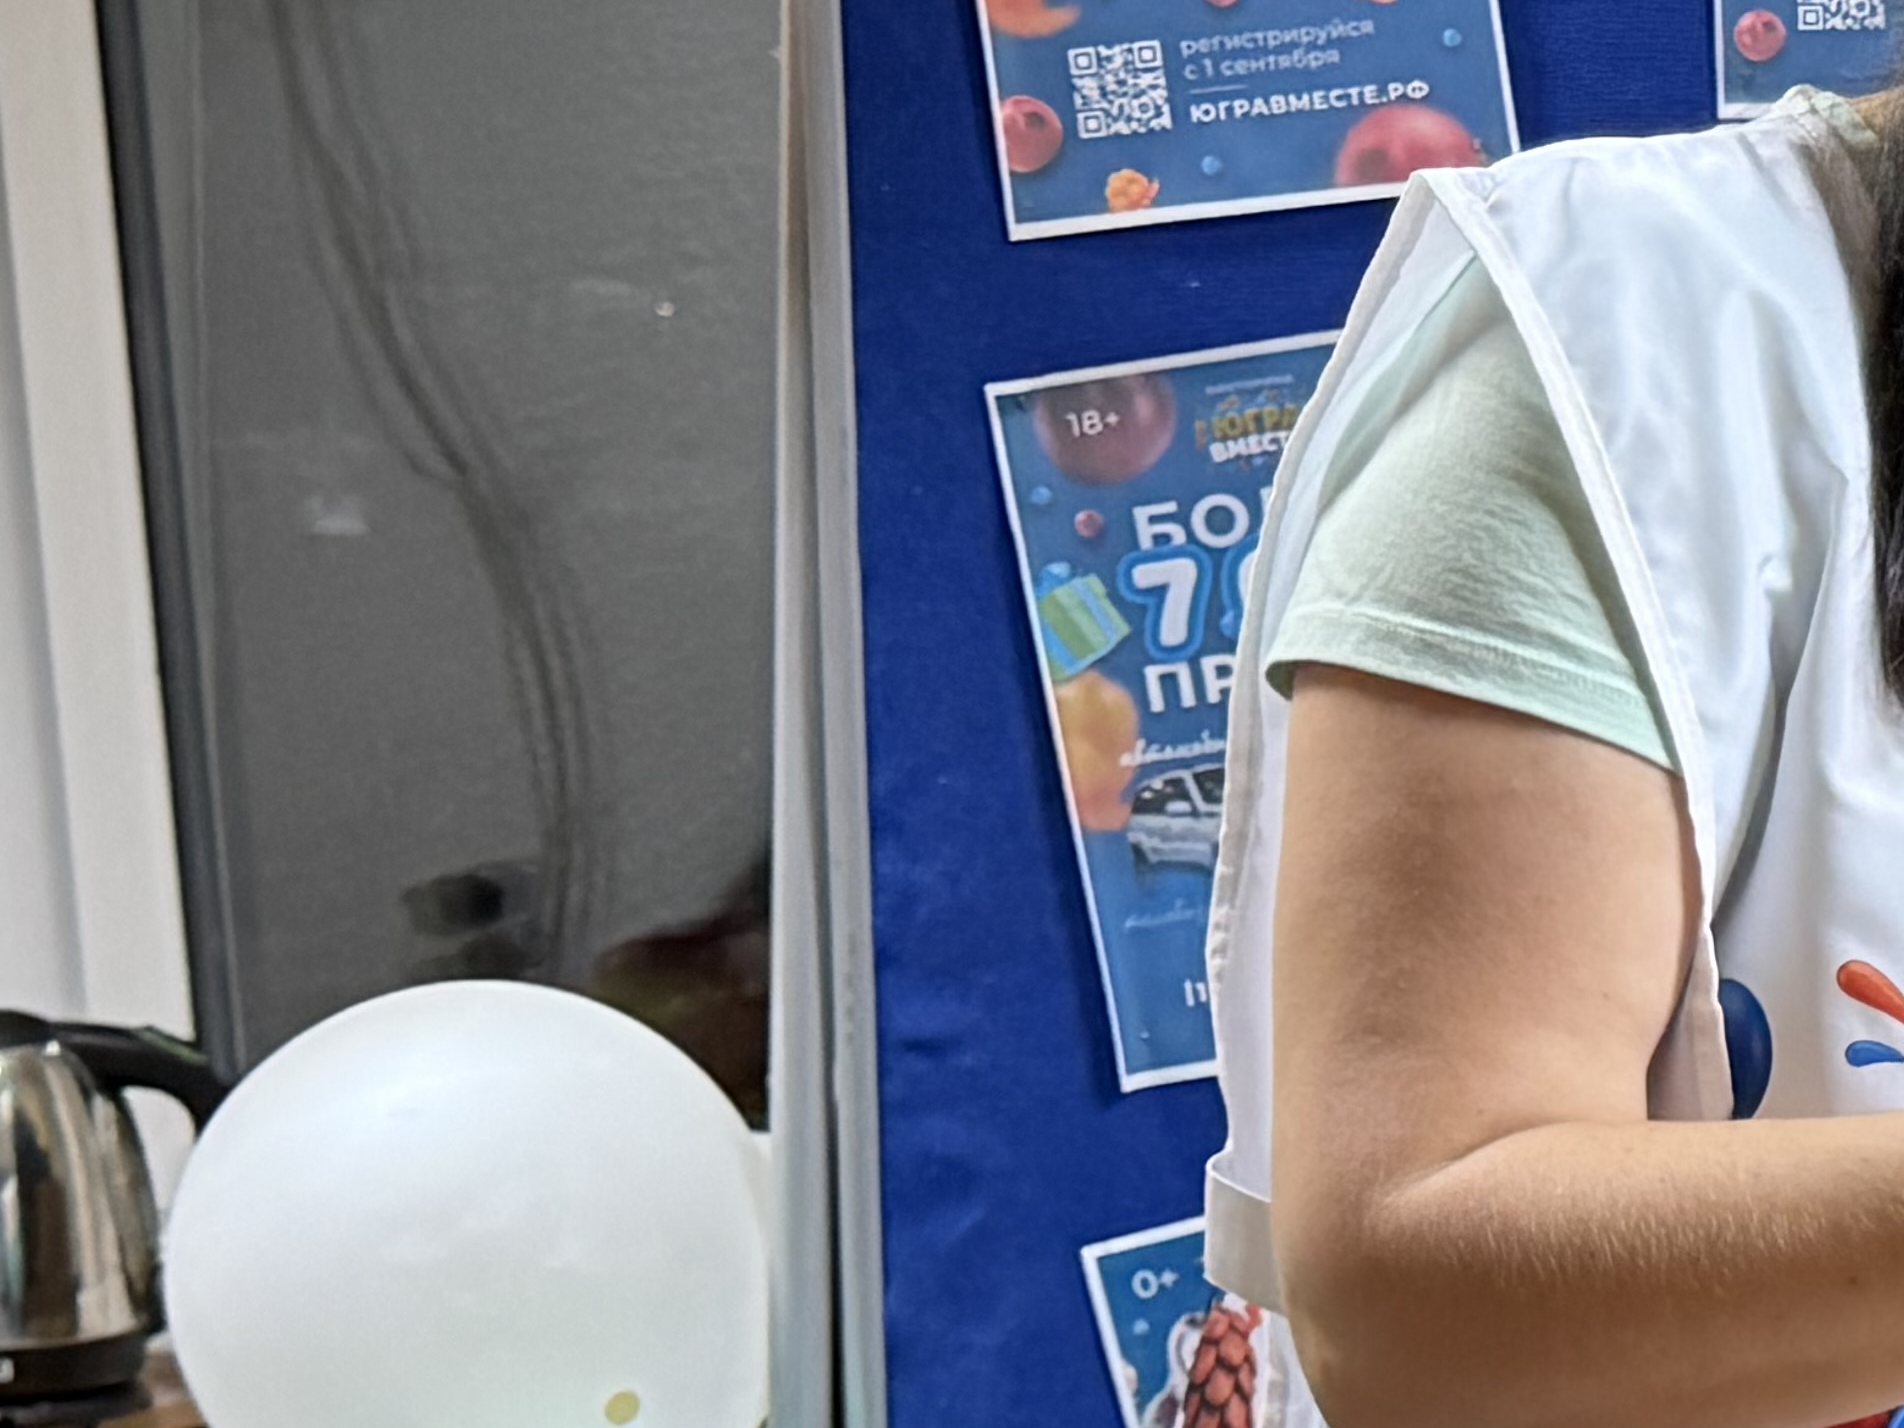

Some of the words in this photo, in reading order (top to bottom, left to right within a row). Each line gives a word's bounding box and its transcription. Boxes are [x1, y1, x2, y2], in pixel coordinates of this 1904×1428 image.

[1179, 17, 1376, 59] регистрируйся
[1218, 47, 1342, 78] сентября
[1189, 78, 1432, 125] ЮГРАВМЕСТЕ.РФ
[1065, 407, 1122, 440] 18+
[1209, 430, 1293, 463] ВМЕСТ
[1131, 486, 1274, 551] БО
[1144, 653, 1237, 714] ПР
[1132, 1269, 1179, 1299] 0+
